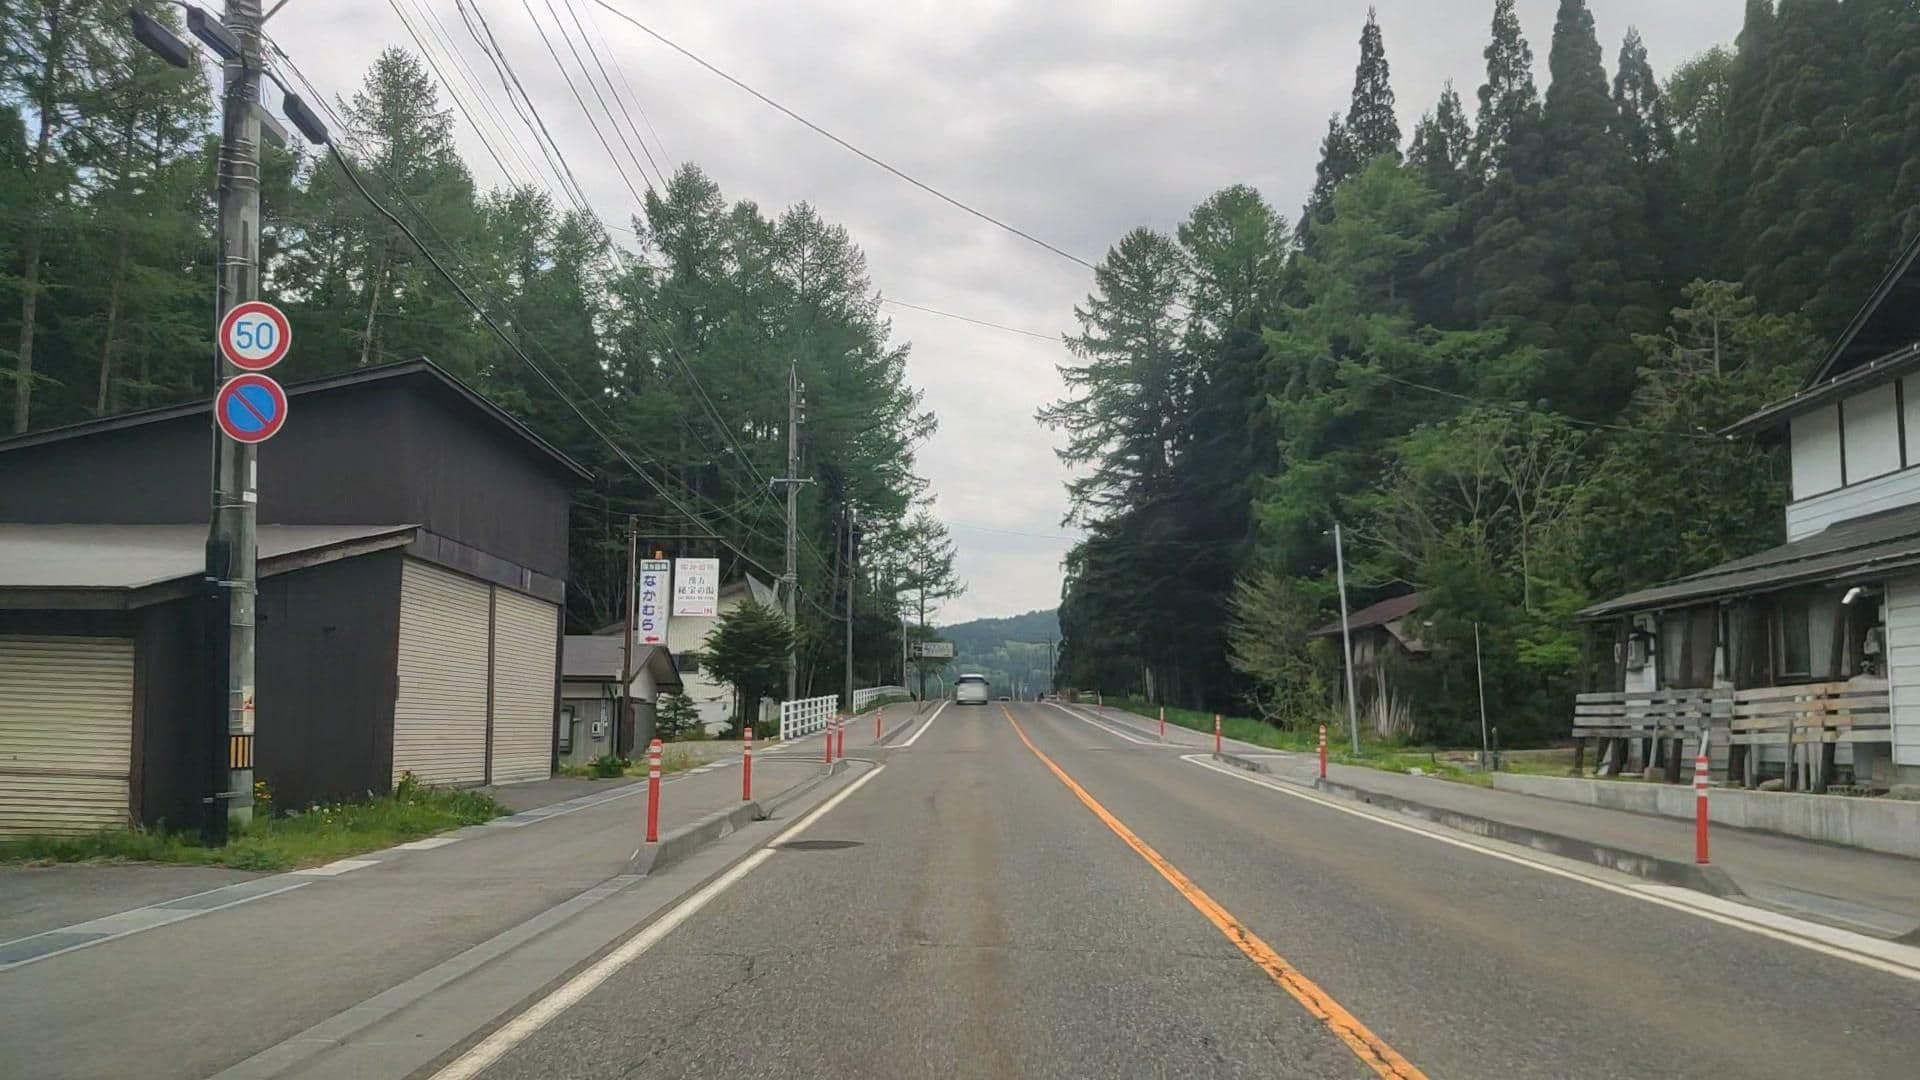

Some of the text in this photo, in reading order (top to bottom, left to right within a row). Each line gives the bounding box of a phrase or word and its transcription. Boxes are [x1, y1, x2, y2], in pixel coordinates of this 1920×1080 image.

[237, 322, 273, 350] 50
[642, 575, 657, 631] なかむら
